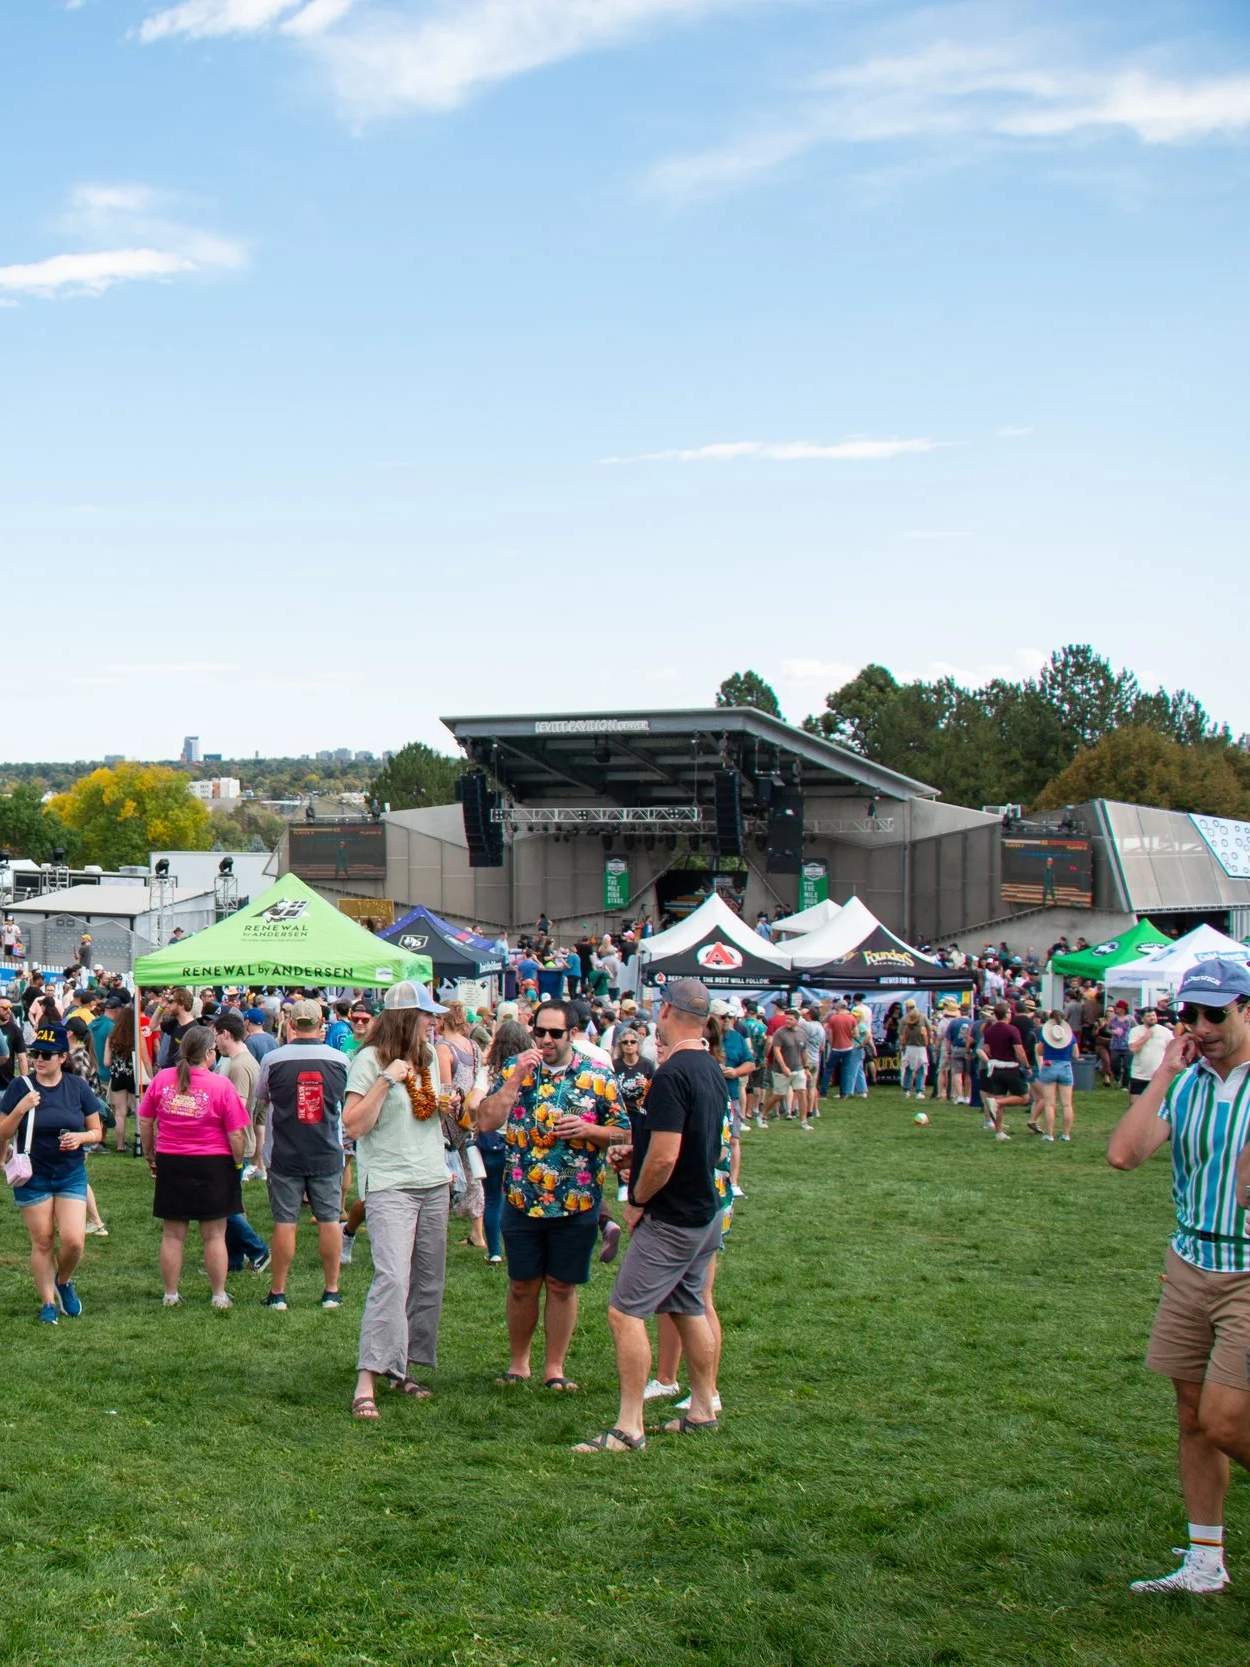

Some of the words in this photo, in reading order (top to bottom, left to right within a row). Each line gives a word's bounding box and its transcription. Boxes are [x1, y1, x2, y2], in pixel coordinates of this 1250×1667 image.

[569, 719, 618, 732] PAVILION
[863, 949, 915, 967] Founders
[182, 965, 255, 976] RENEWAL
[258, 965, 269, 976] by
[272, 966, 353, 977] ANDERSEN
[37, 1030, 56, 1042] CAL
